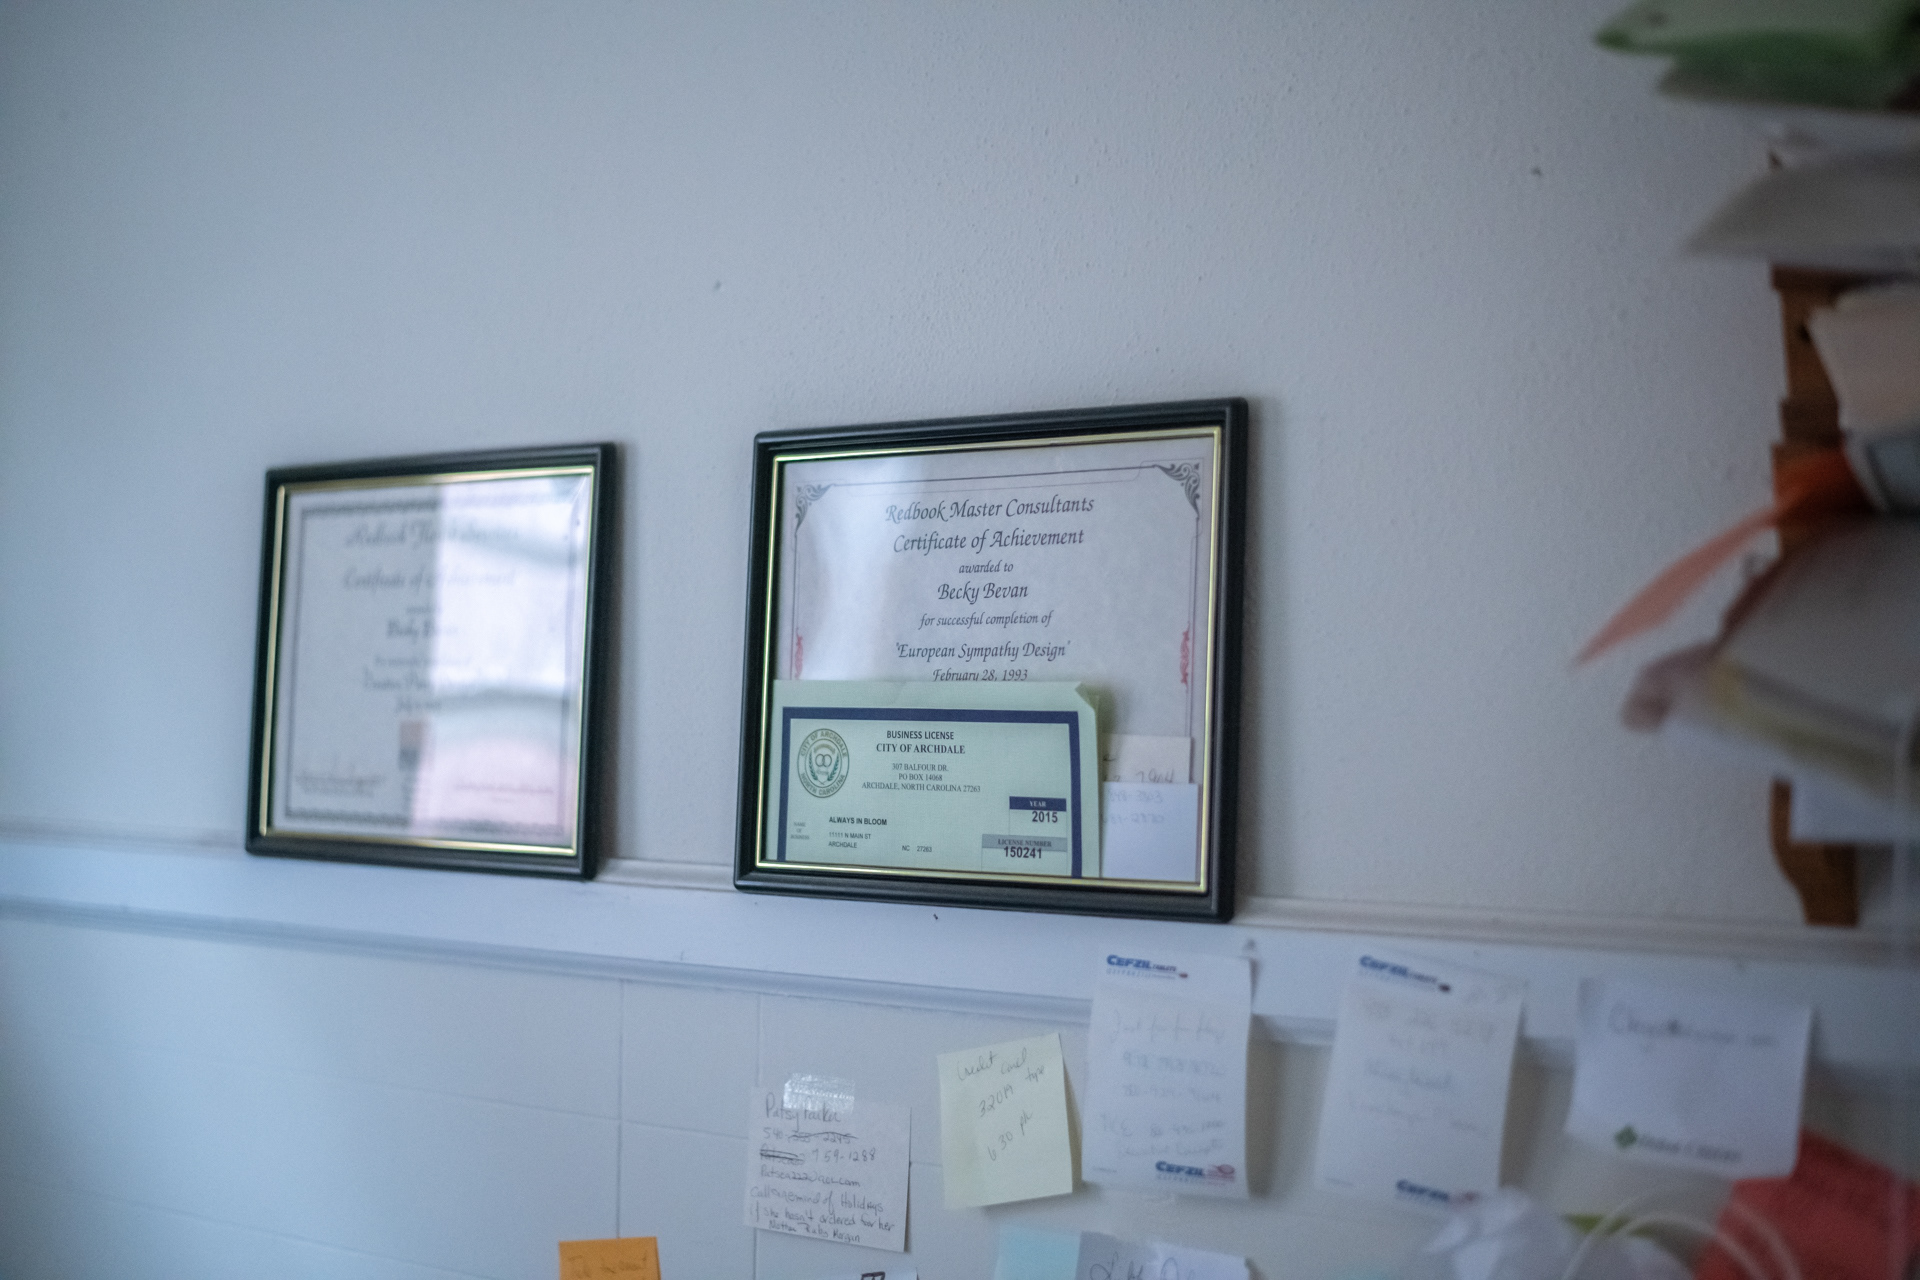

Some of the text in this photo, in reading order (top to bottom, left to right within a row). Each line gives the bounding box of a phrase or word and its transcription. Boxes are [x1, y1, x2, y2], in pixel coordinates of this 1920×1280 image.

[885, 494, 1095, 524] Redbook Master Consultants
[893, 528, 1085, 556] Certificate of Achievement
[958, 560, 1014, 574] awarded to
[938, 580, 1029, 605] Becky Bevan
[918, 610, 1054, 630] for successful completion of
[957, 641, 1020, 663] Sympathy
[932, 668, 980, 682] February
[1001, 669, 1029, 682] 1993
[886, 730, 955, 740] BUSINESS LICENSE
[876, 743, 966, 754] CITY OF ARCHDALE
[892, 763, 903, 771] 307
[903, 763, 936, 772] BALFOUR
[898, 773, 943, 782] PO BOX 14068
[901, 783, 925, 791] NORTH
[926, 784, 962, 792] CAROLINA
[963, 785, 981, 793] 27263
[1029, 800, 1047, 808] YEAR
[828, 816, 888, 826] ALWAYS IN BLOOM
[1032, 810, 1058, 823] 2015
[828, 841, 858, 849] ARCHDALE
[916, 845, 933, 853] 27263
[997, 838, 1023, 846] LICENSE
[1003, 846, 1042, 859] 150241
